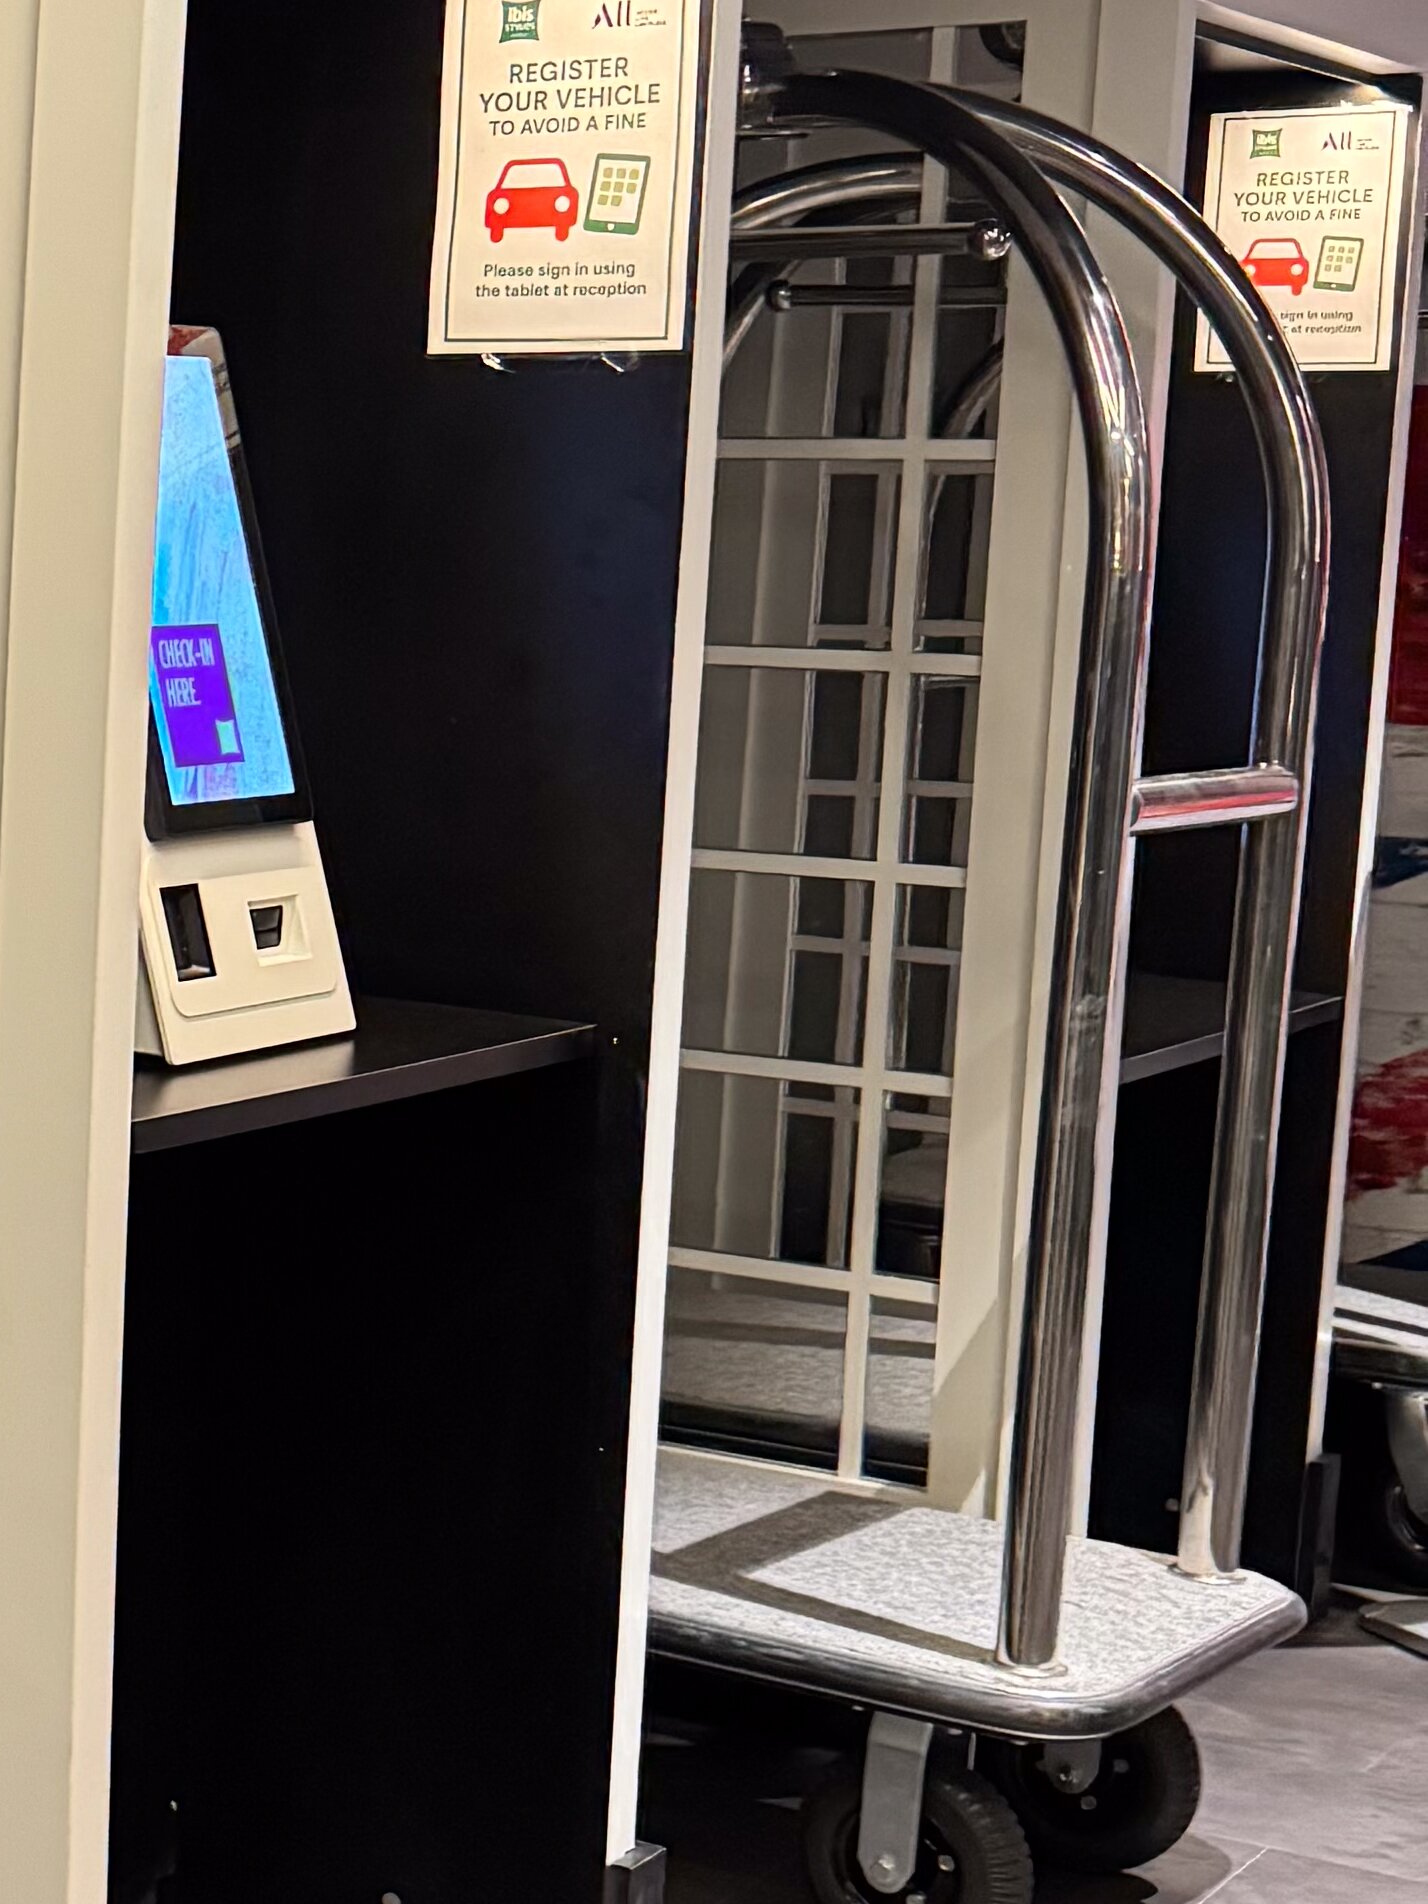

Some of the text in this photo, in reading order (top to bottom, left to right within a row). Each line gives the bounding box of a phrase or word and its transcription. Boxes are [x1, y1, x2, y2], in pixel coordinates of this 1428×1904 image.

[509, 57, 629, 84] REGISTER
[479, 83, 661, 114] YOUR VEHICLE
[489, 112, 647, 136] TO AVOID A FINE
[1256, 169, 1350, 187] REGISTER
[1233, 188, 1374, 207] YOUR VEHICLE
[1241, 208, 1362, 222] TO AVOID A FINE
[483, 261, 636, 280] Please sign in using
[475, 284, 501, 298] the
[553, 283, 569, 297] at
[157, 637, 216, 669] CHECK-IN
